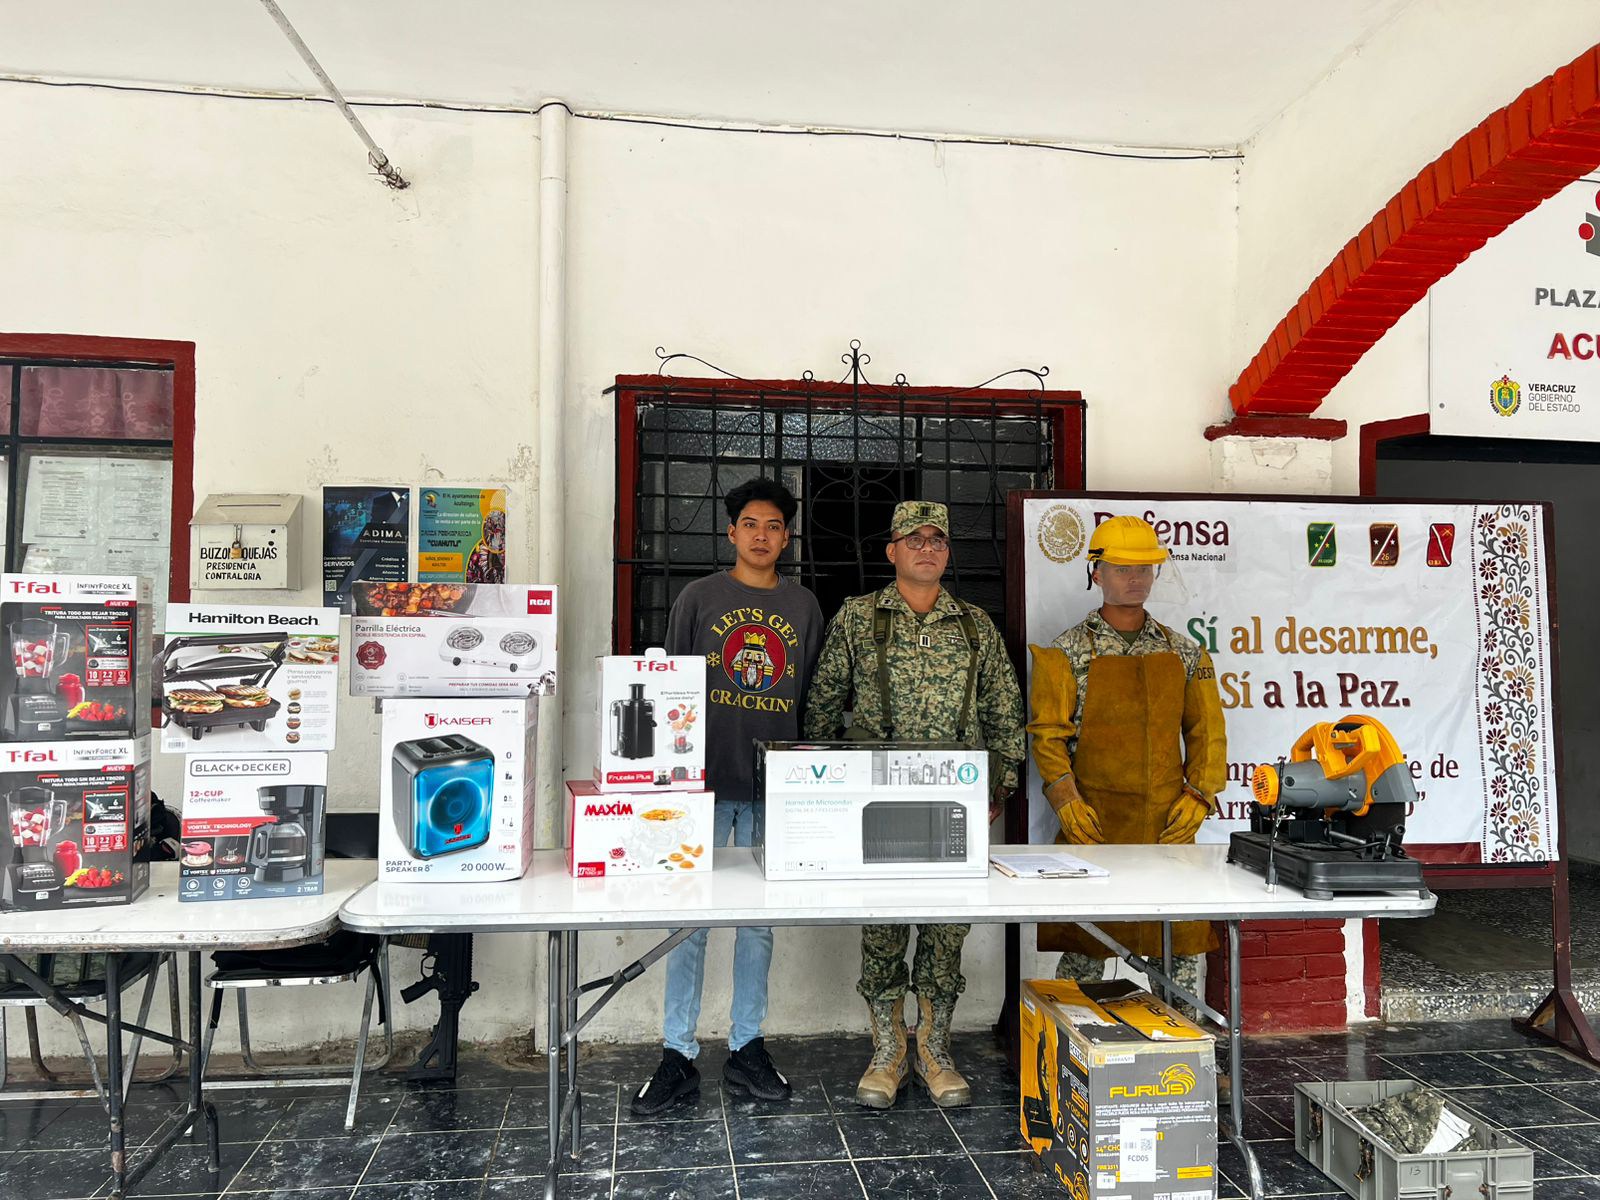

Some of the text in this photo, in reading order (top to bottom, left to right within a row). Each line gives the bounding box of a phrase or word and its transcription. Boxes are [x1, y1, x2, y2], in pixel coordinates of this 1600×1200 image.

[1536, 287, 1600, 308] PLAZ
[1547, 332, 1600, 361] AC
[1528, 383, 1578, 394] VERACRUZ
[1528, 392, 1573, 403] GOBIERNO
[1528, 402, 1581, 413] DEL ESTADO
[363, 529, 402, 538] ADIMA
[1191, 553, 1226, 561] Nacional
[206, 562, 256, 570] PRESIDENCIA
[205, 572, 262, 580] CONTRALORIA
[529, 598, 551, 606] RCA
[188, 612, 319, 626] Hamilton Beach
[355, 623, 421, 632] Parrilla Eléctrica
[710, 607, 799, 648] LET'S GET
[1187, 616, 1437, 659] Sí al desarme,
[633, 660, 678, 672] T-fal
[1219, 671, 1411, 709] Sí a la Paz.
[709, 688, 794, 713] CRACKIN'
[439, 717, 492, 726] KAISER
[195, 762, 287, 773] BLACK+DECKER
[1430, 753, 1459, 779] de
[190, 790, 224, 798] 12-CUP
[461, 863, 474, 872] 20
[1109, 1084, 1184, 1099] FURIUS
